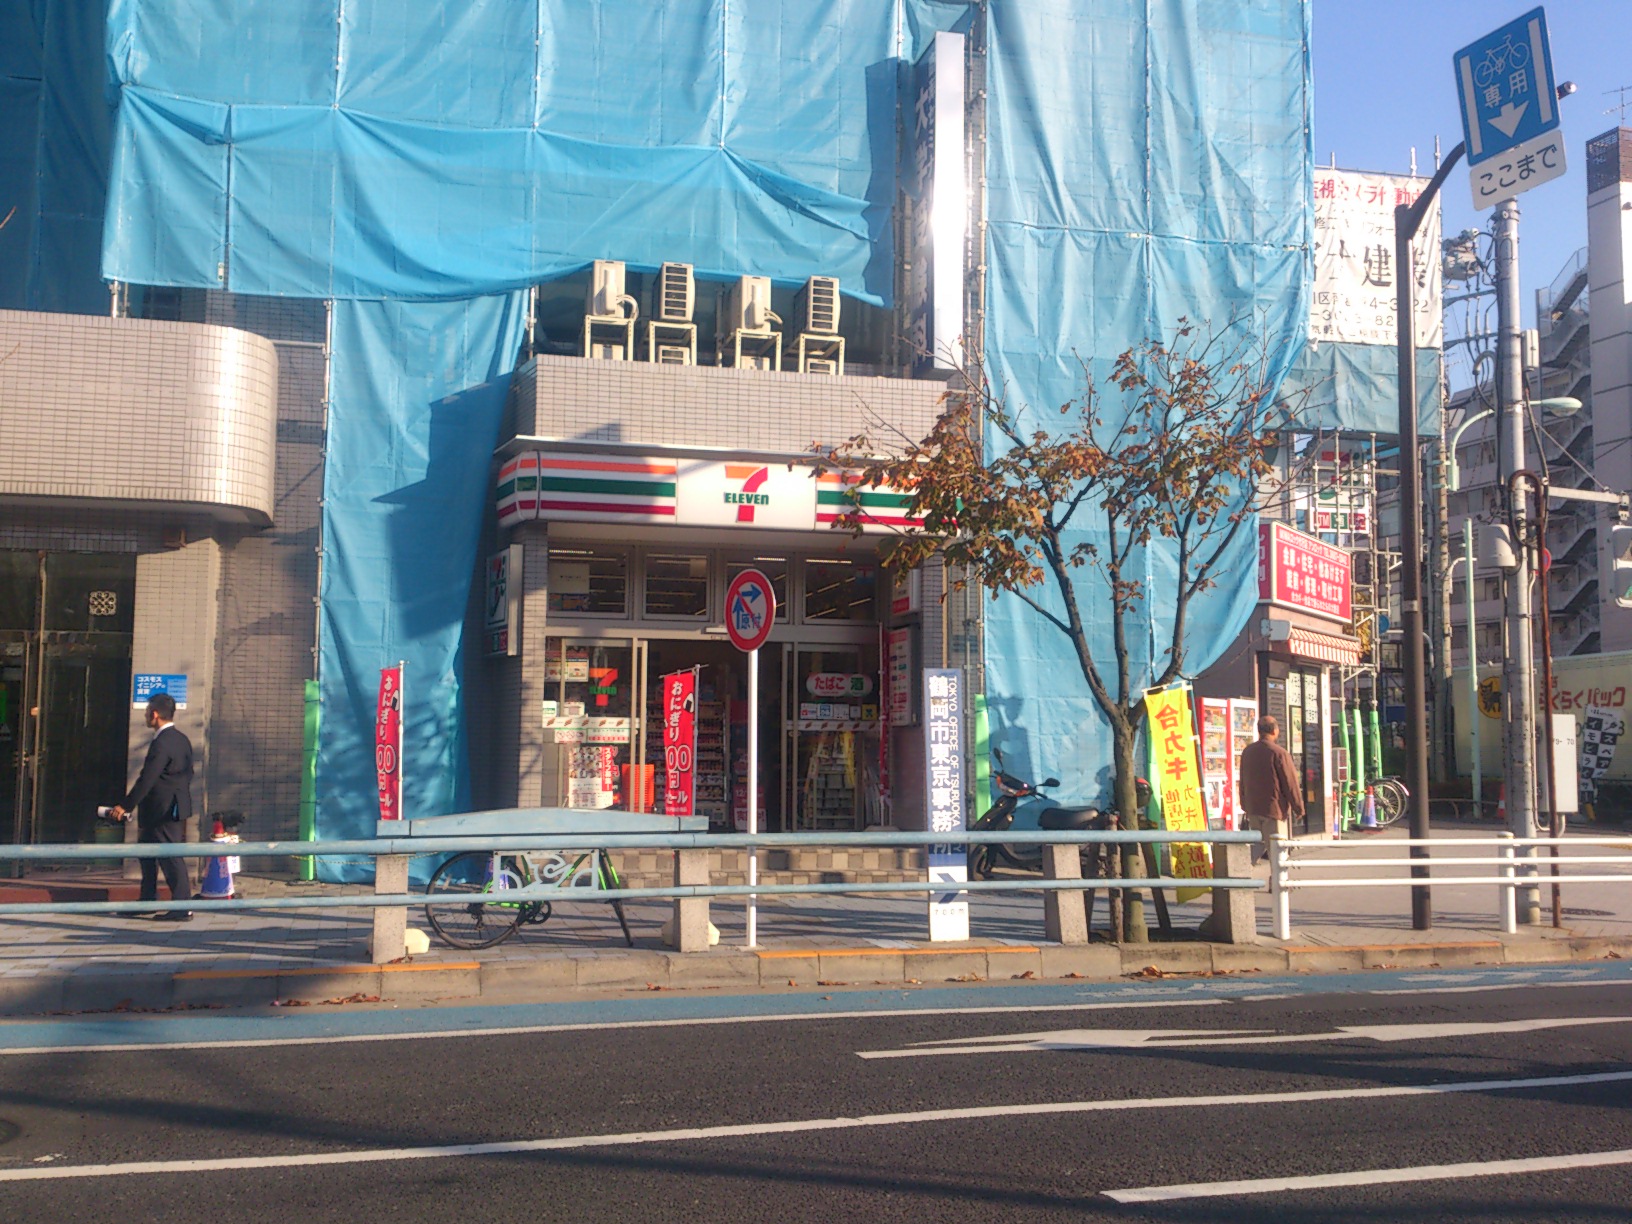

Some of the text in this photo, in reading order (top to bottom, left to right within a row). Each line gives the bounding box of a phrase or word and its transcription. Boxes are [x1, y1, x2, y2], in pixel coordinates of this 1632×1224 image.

[1483, 70, 1528, 108] 専用
[1480, 144, 1557, 196] ここまで
[724, 464, 769, 523] 7
[724, 492, 769, 506] ELEVEN
[741, 612, 762, 630] 原付
[137, 675, 162, 683] コスモス
[814, 676, 846, 691] たばこ
[850, 676, 864, 691] 酒
[379, 675, 393, 741] おにぎり
[669, 681, 683, 742] おにぎり
[948, 676, 962, 828] TOKYO OFFICE OF TSURUOKA
